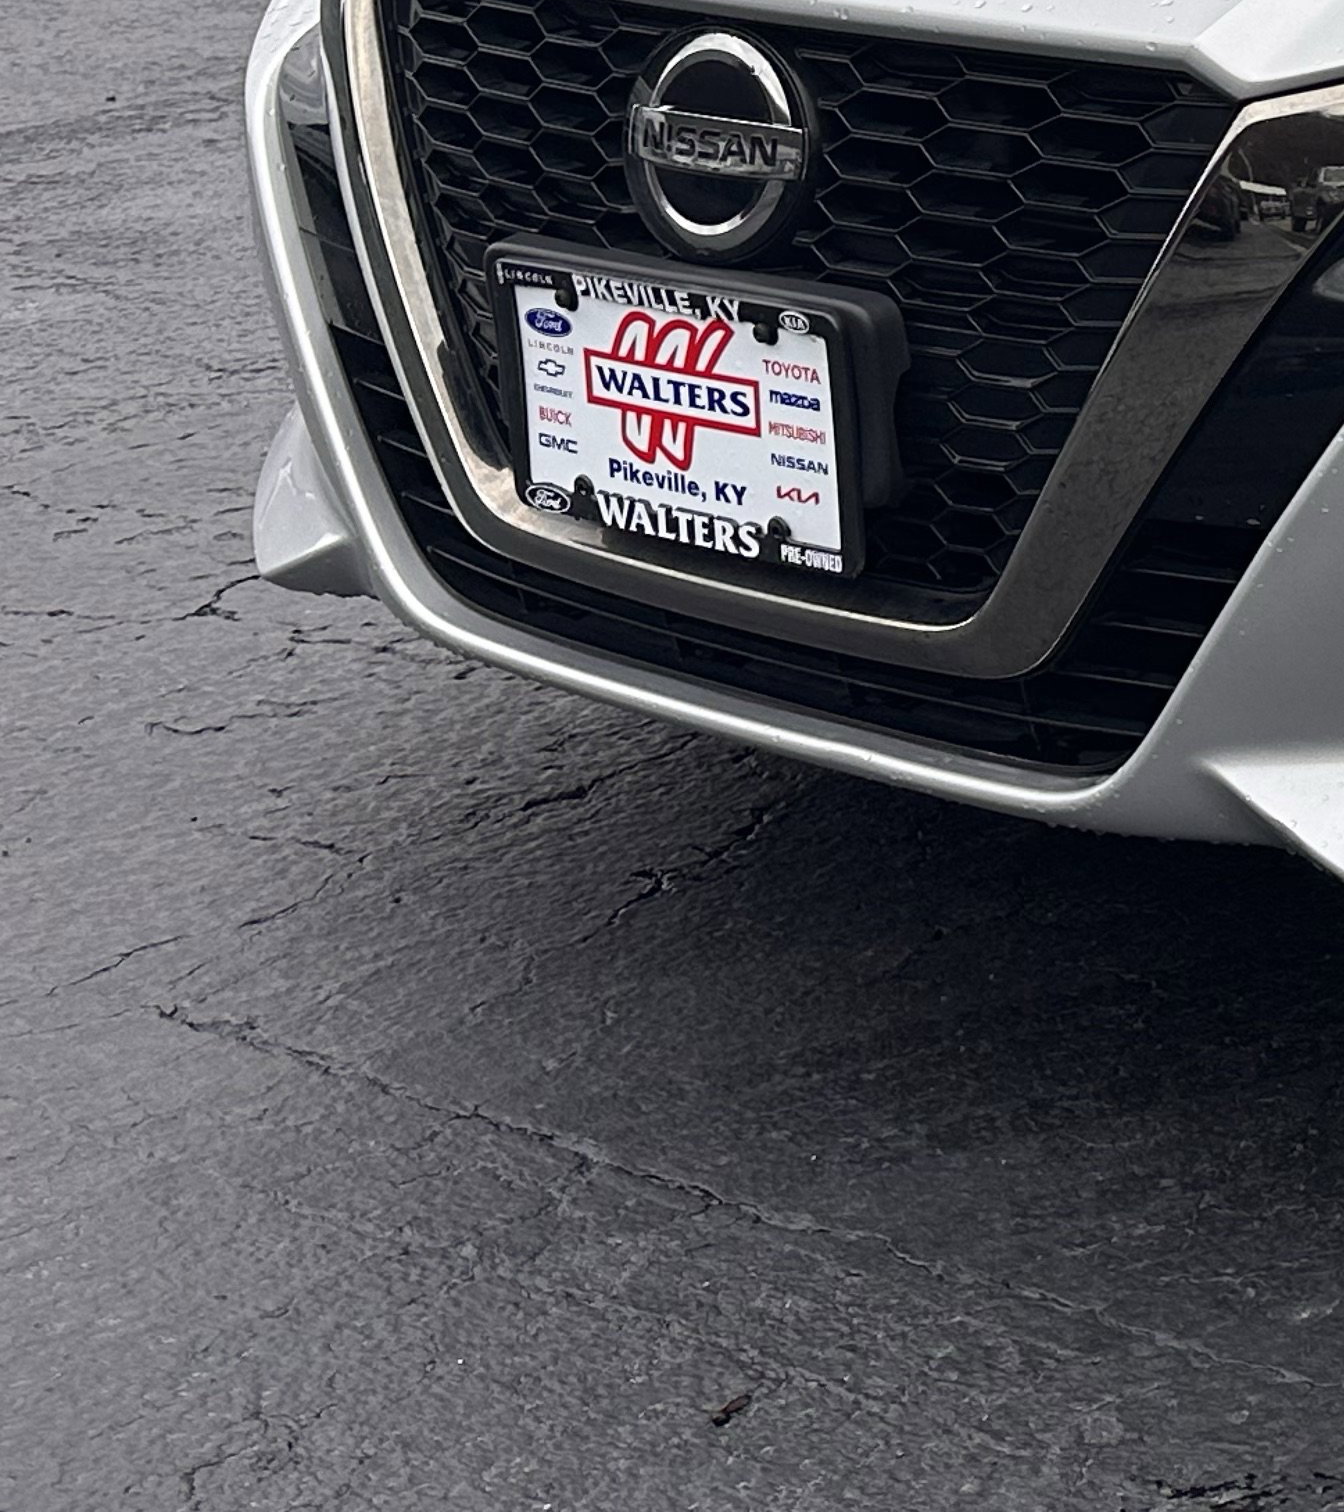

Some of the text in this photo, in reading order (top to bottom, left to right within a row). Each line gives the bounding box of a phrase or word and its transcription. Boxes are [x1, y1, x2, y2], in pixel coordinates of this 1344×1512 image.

[643, 117, 778, 167] NISSAN
[572, 273, 740, 322] PIKEVILLE, KY
[762, 359, 821, 385] TOYOTA
[595, 364, 751, 417] WALTERS
[538, 405, 572, 428] BUICK
[538, 432, 579, 454] GMC
[768, 421, 826, 445] MITSUBISHI
[770, 453, 829, 476] NISSAN
[608, 457, 747, 506] Pikeville, KY
[597, 493, 760, 559] WALTERS
[780, 544, 843, 573] PRE-OWNED
